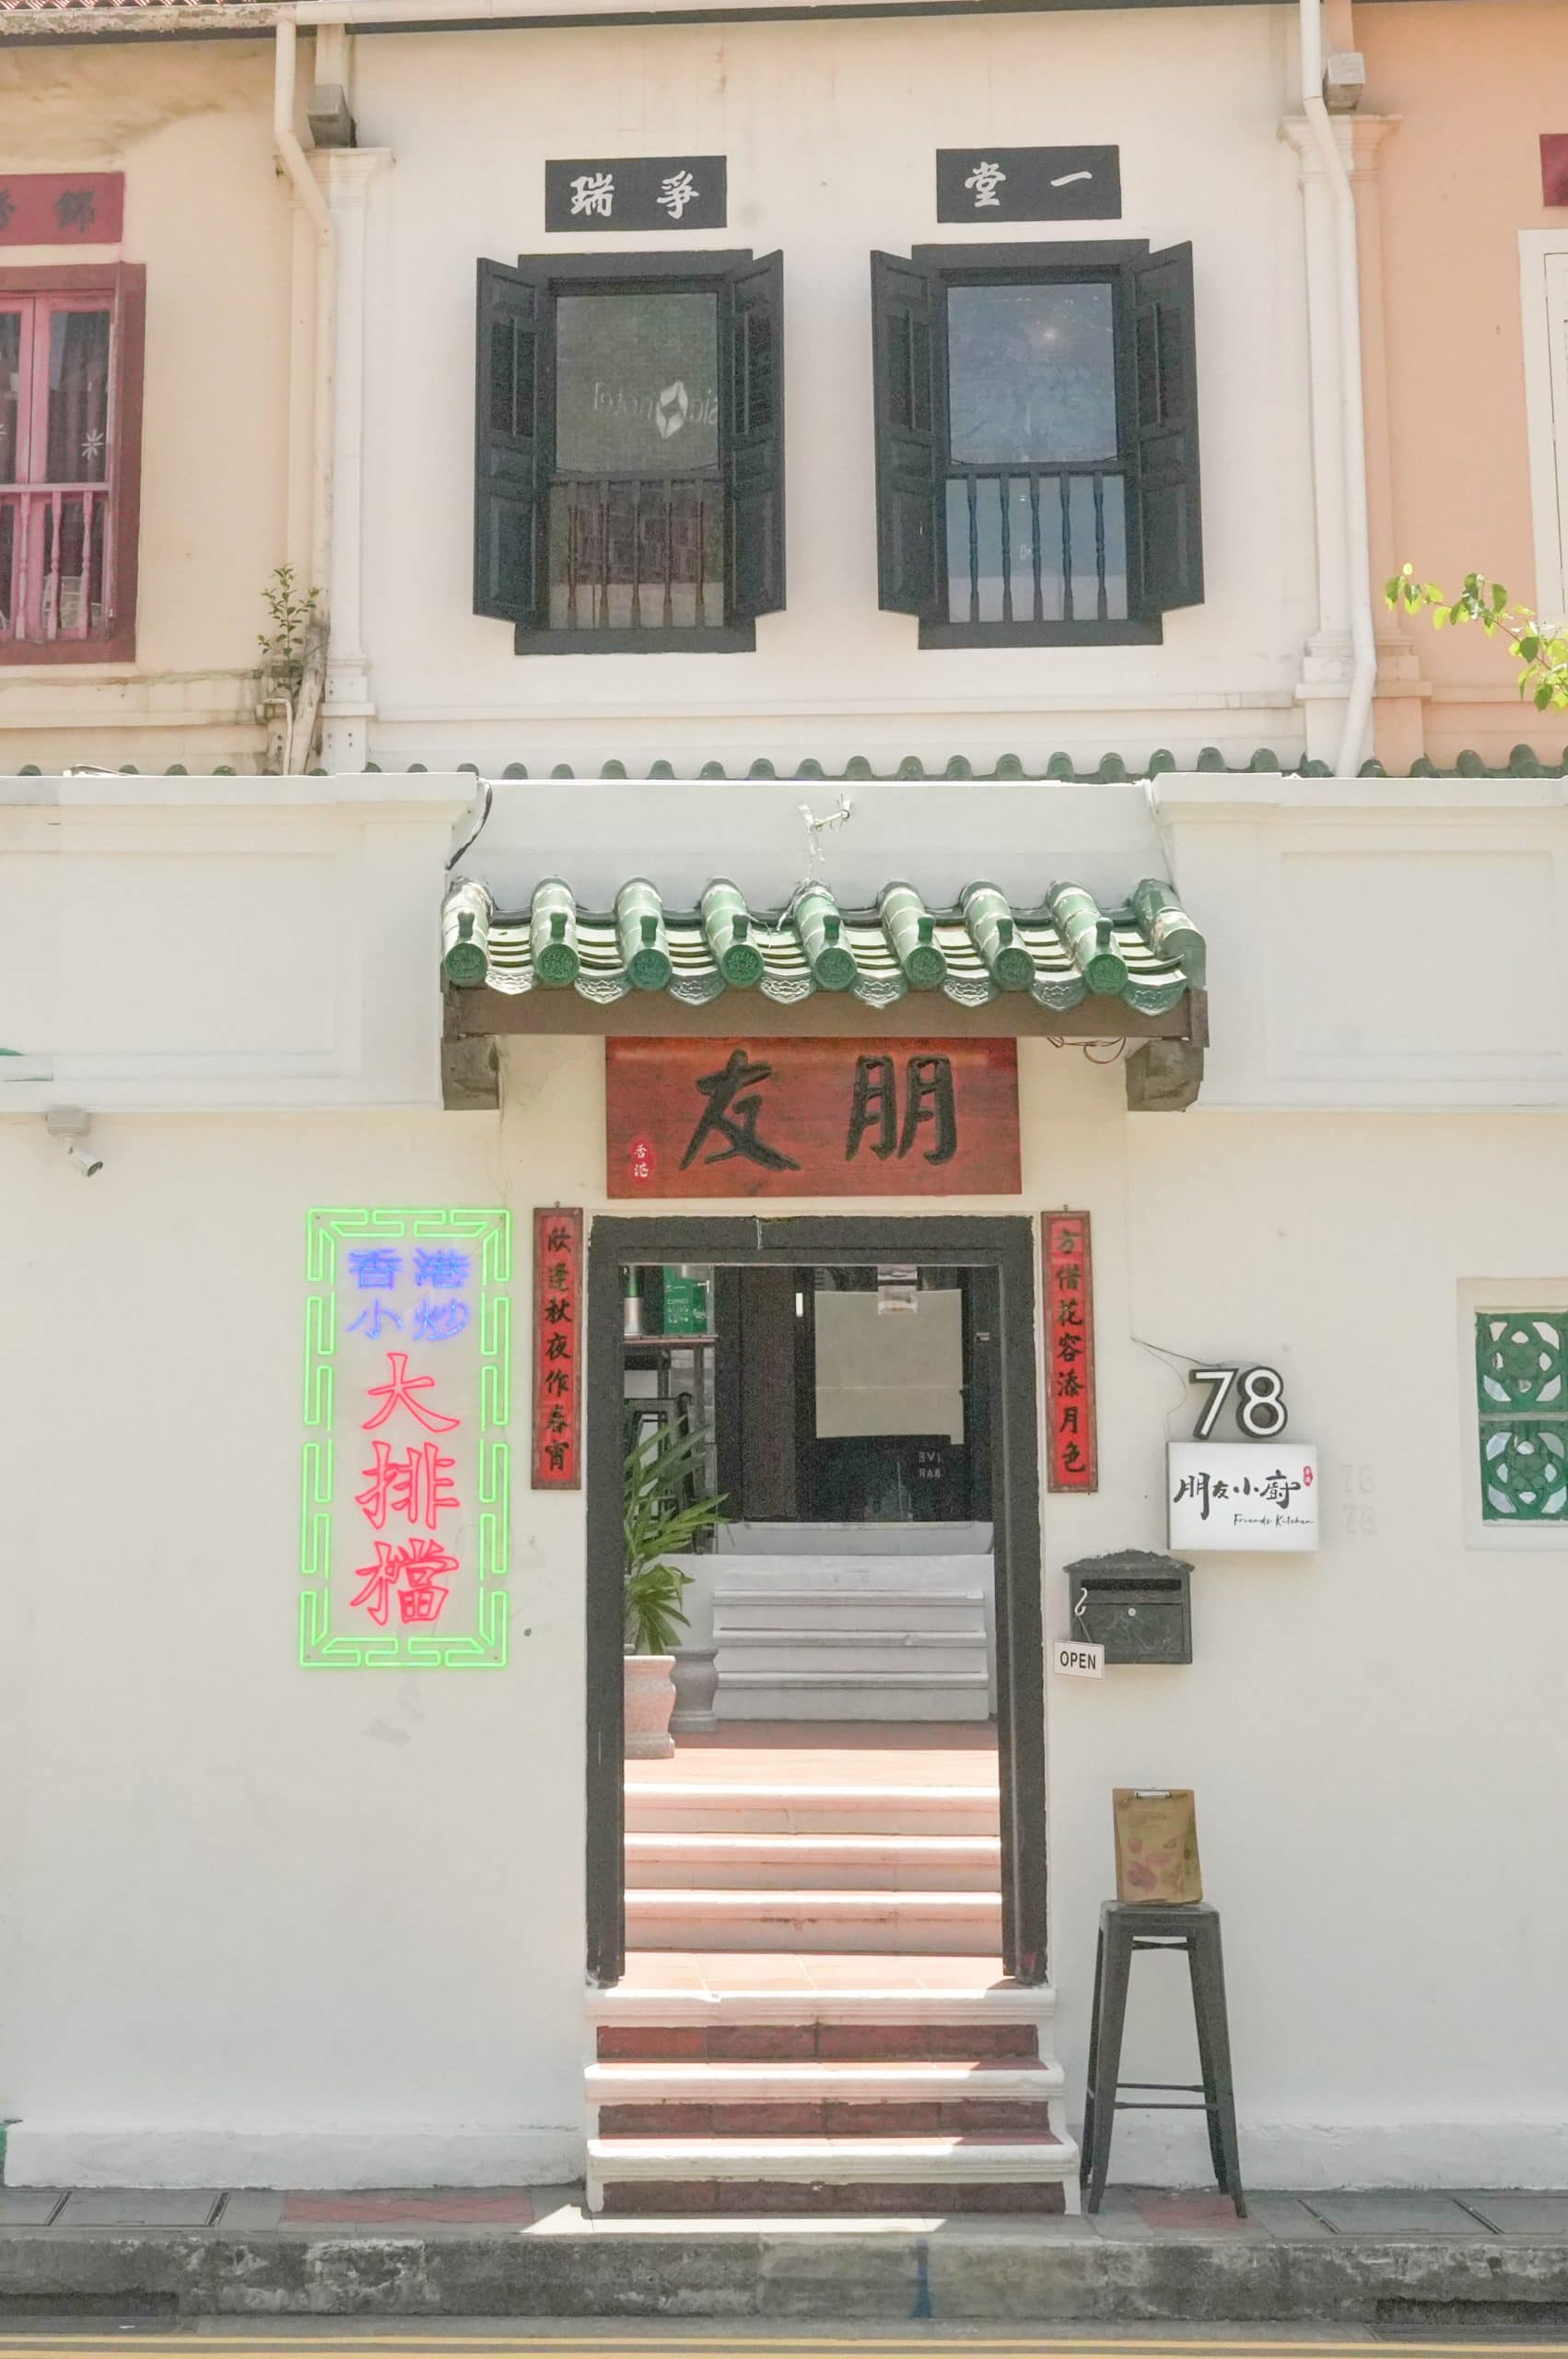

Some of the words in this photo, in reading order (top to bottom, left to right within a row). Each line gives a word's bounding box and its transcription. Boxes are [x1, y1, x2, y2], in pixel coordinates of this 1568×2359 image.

[347, 1247, 470, 1290] 香港
[346, 1297, 470, 1342] 小炒
[1189, 1366, 1288, 1440] 78
[1234, 1513, 1271, 1527] Friends
[1275, 1514, 1315, 1527] Kitchen
[1060, 1650, 1095, 1670] OPEN
